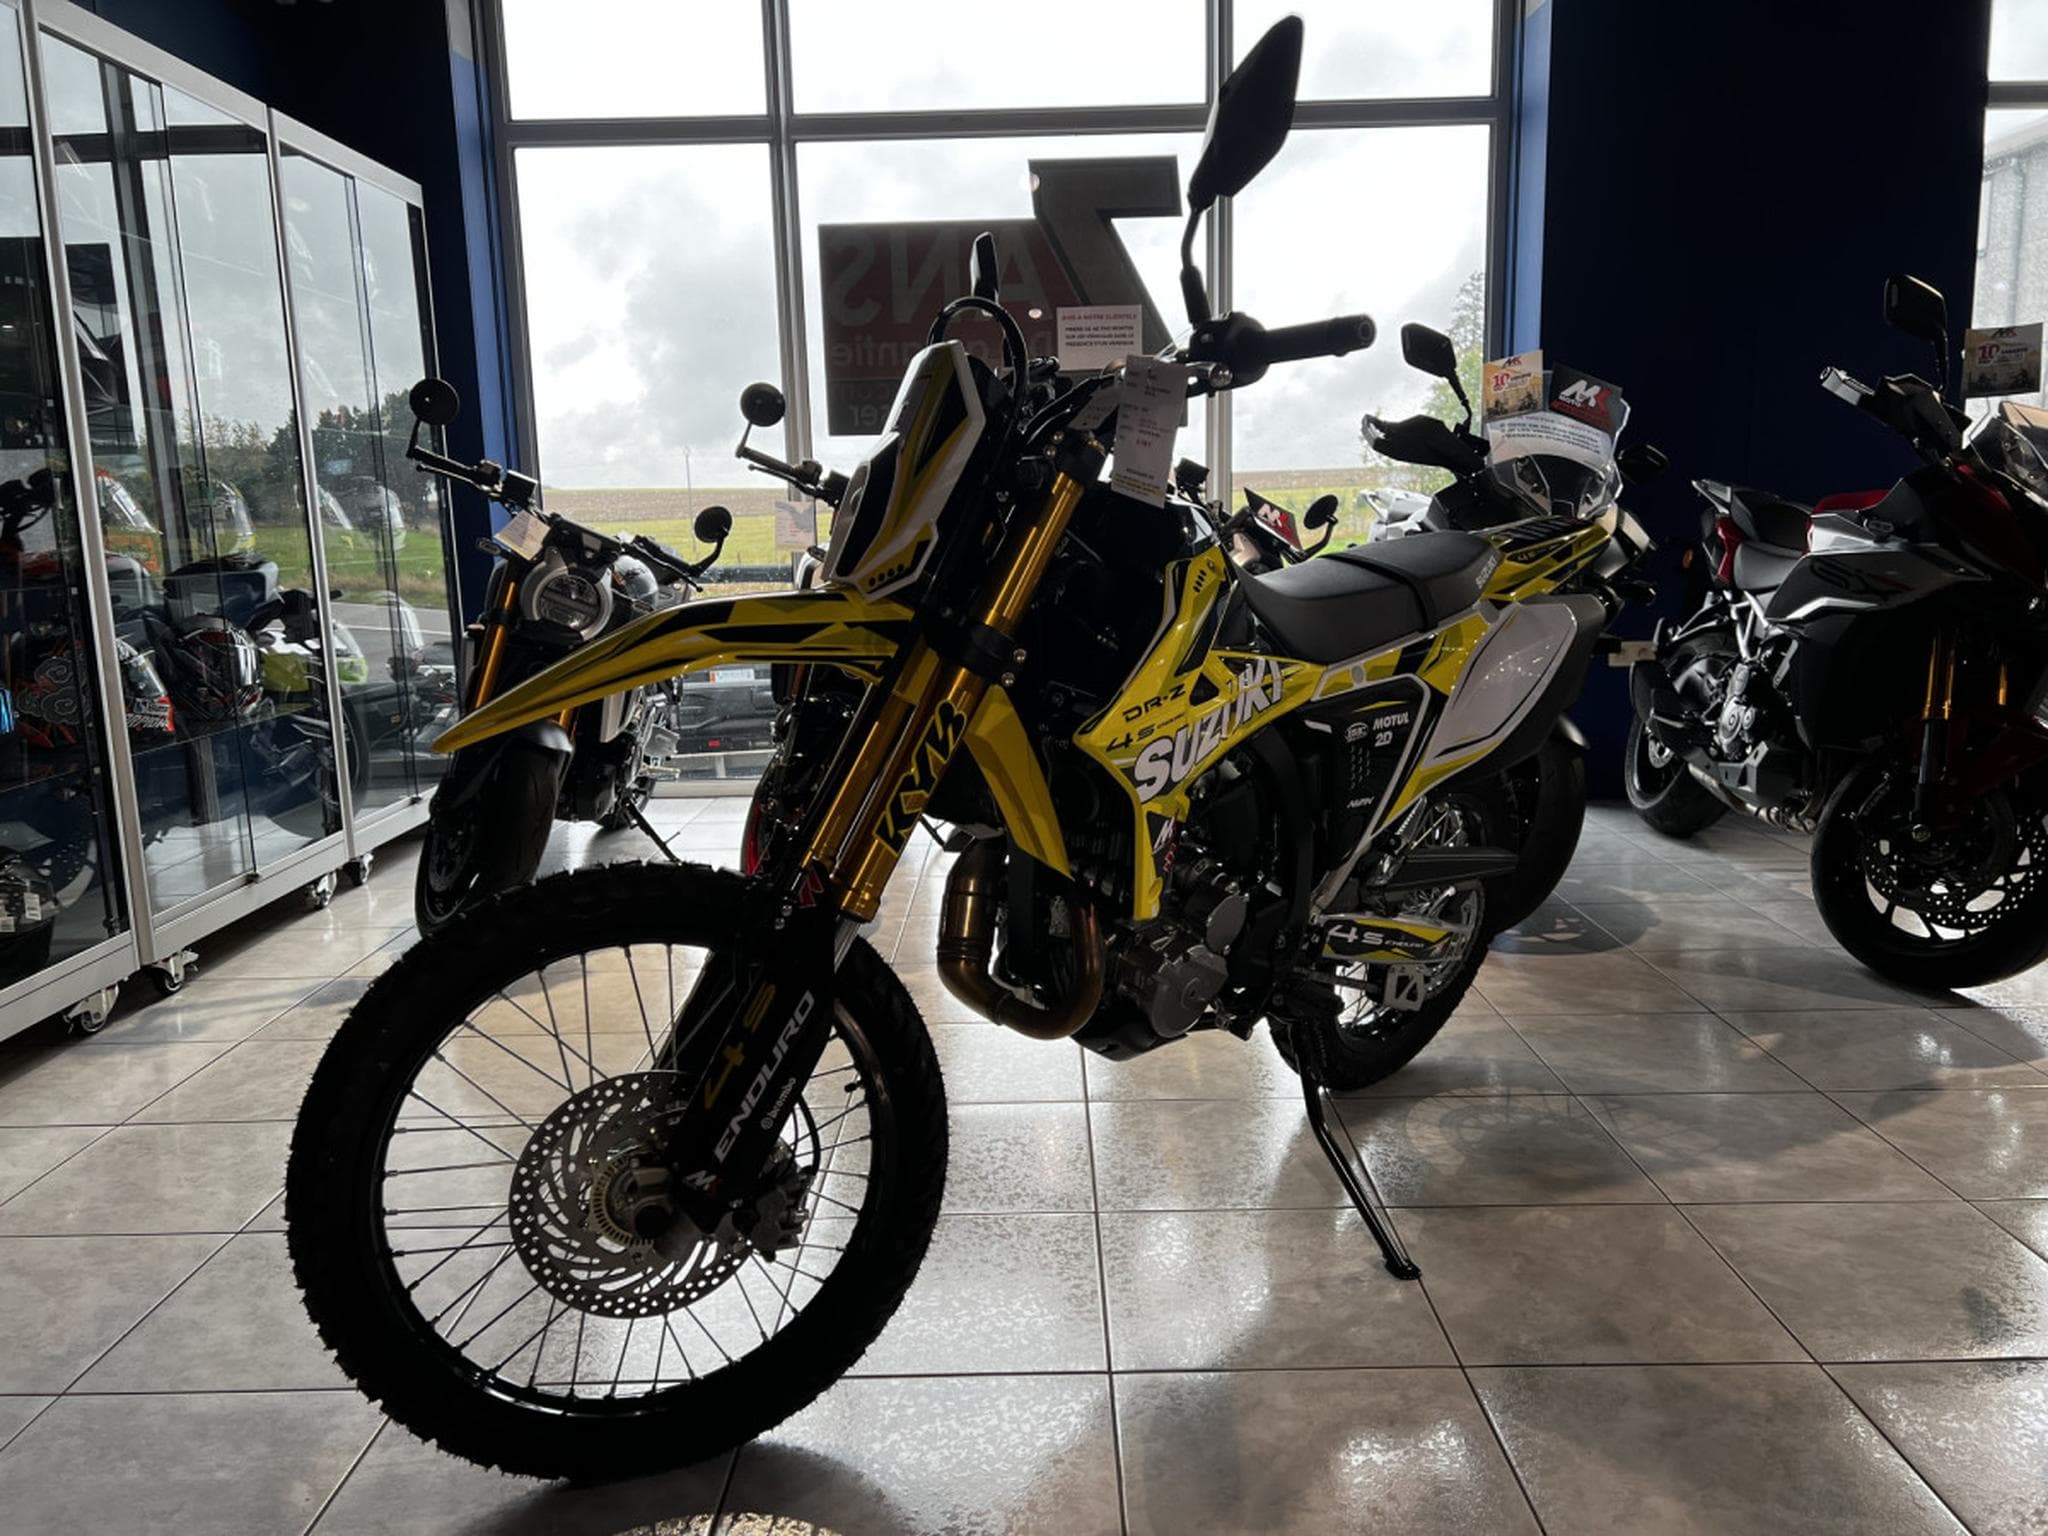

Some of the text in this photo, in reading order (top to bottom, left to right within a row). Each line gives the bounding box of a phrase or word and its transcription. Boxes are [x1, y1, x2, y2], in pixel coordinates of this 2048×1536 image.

[1134, 656, 1283, 804] SUZUKI
[1372, 711, 1410, 731] MOTUL
[713, 989, 815, 1164] ENDURO
